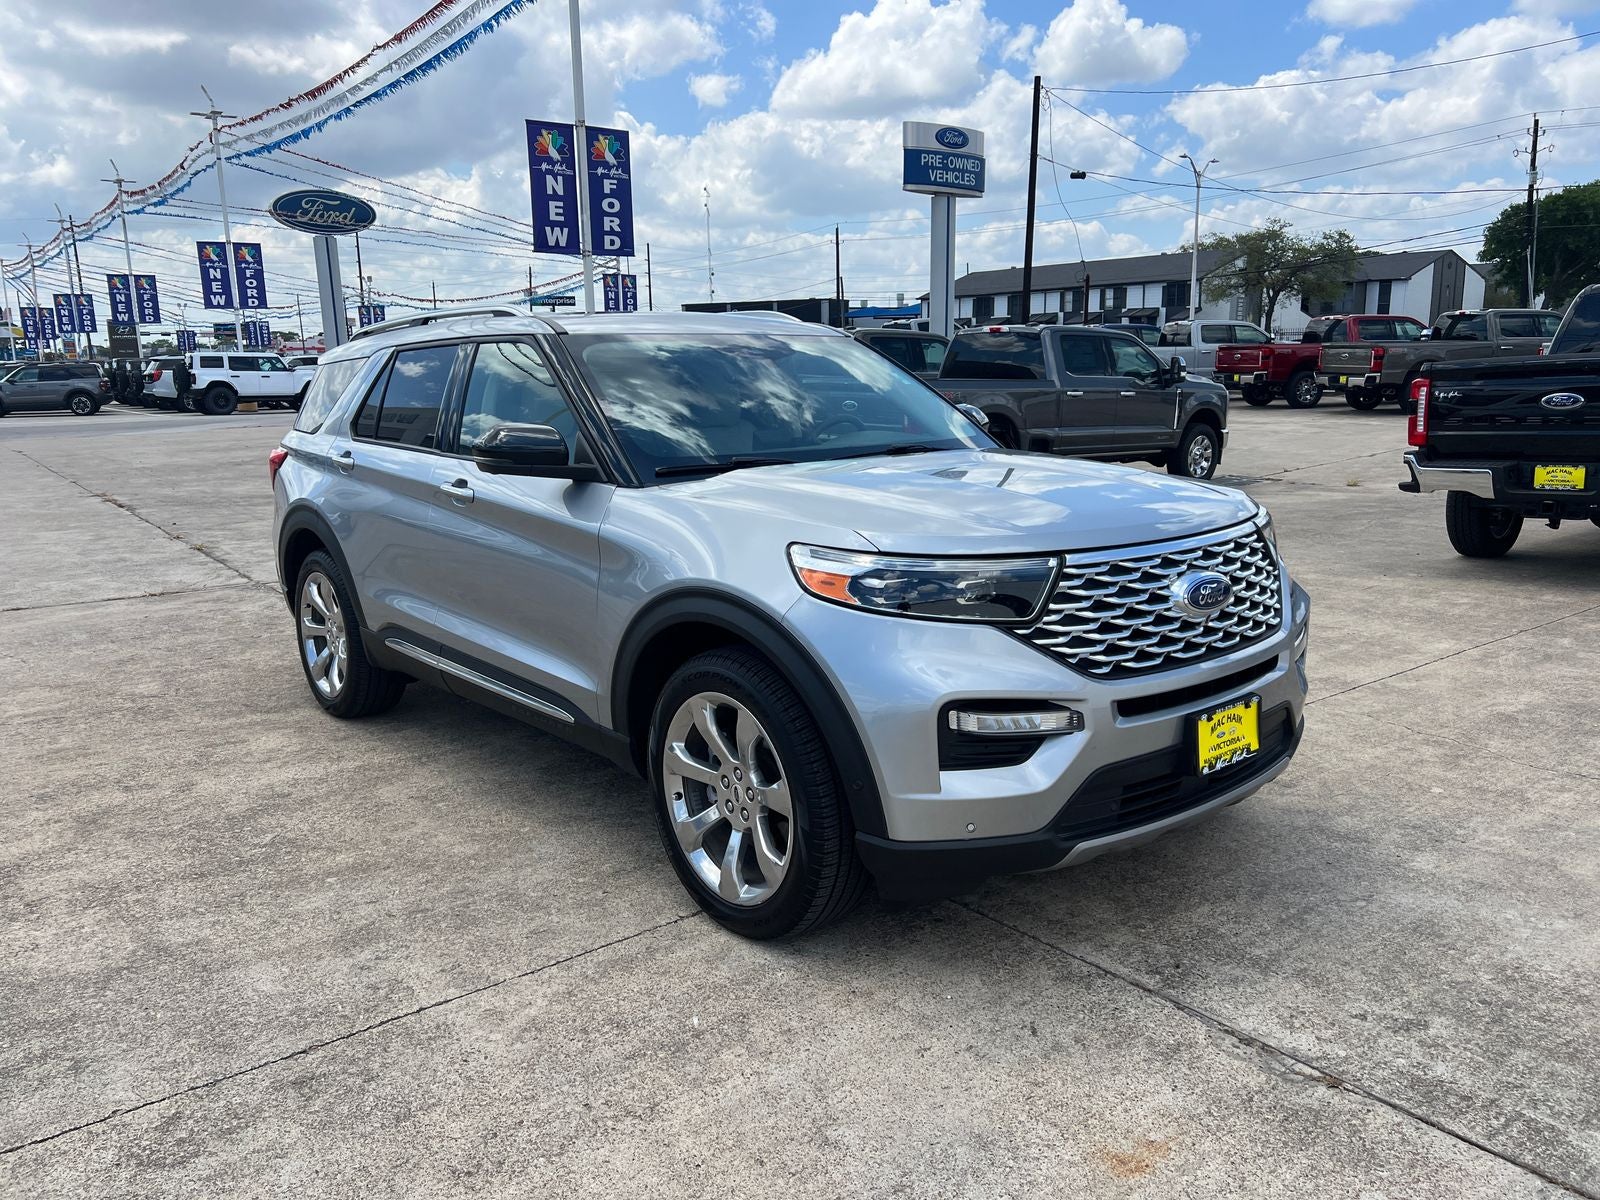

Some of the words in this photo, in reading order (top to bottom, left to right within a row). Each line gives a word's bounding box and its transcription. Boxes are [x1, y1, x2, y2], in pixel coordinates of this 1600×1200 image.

[943, 131, 964, 144] Ford
[921, 154, 981, 171] PRE-OWNED
[929, 169, 976, 185] VEHICLES
[297, 197, 356, 224] Ford
[545, 174, 568, 247] NEW
[601, 179, 621, 250] FORD
[209, 268, 226, 305] NEW
[245, 269, 259, 306] FORD
[116, 293, 129, 321] NEW
[143, 294, 154, 322] FORD
[608, 291, 617, 311] NE
[626, 292, 634, 311] FOR
[26, 320, 36, 338] NEW
[44, 320, 52, 338] FORD
[60, 309, 72, 330] NEW
[82, 309, 92, 331] FORD
[1551, 395, 1574, 405] Ford
[1199, 583, 1225, 605] Ford
[1210, 715, 1226, 736] MAC
[1226, 713, 1243, 725] HAIK
